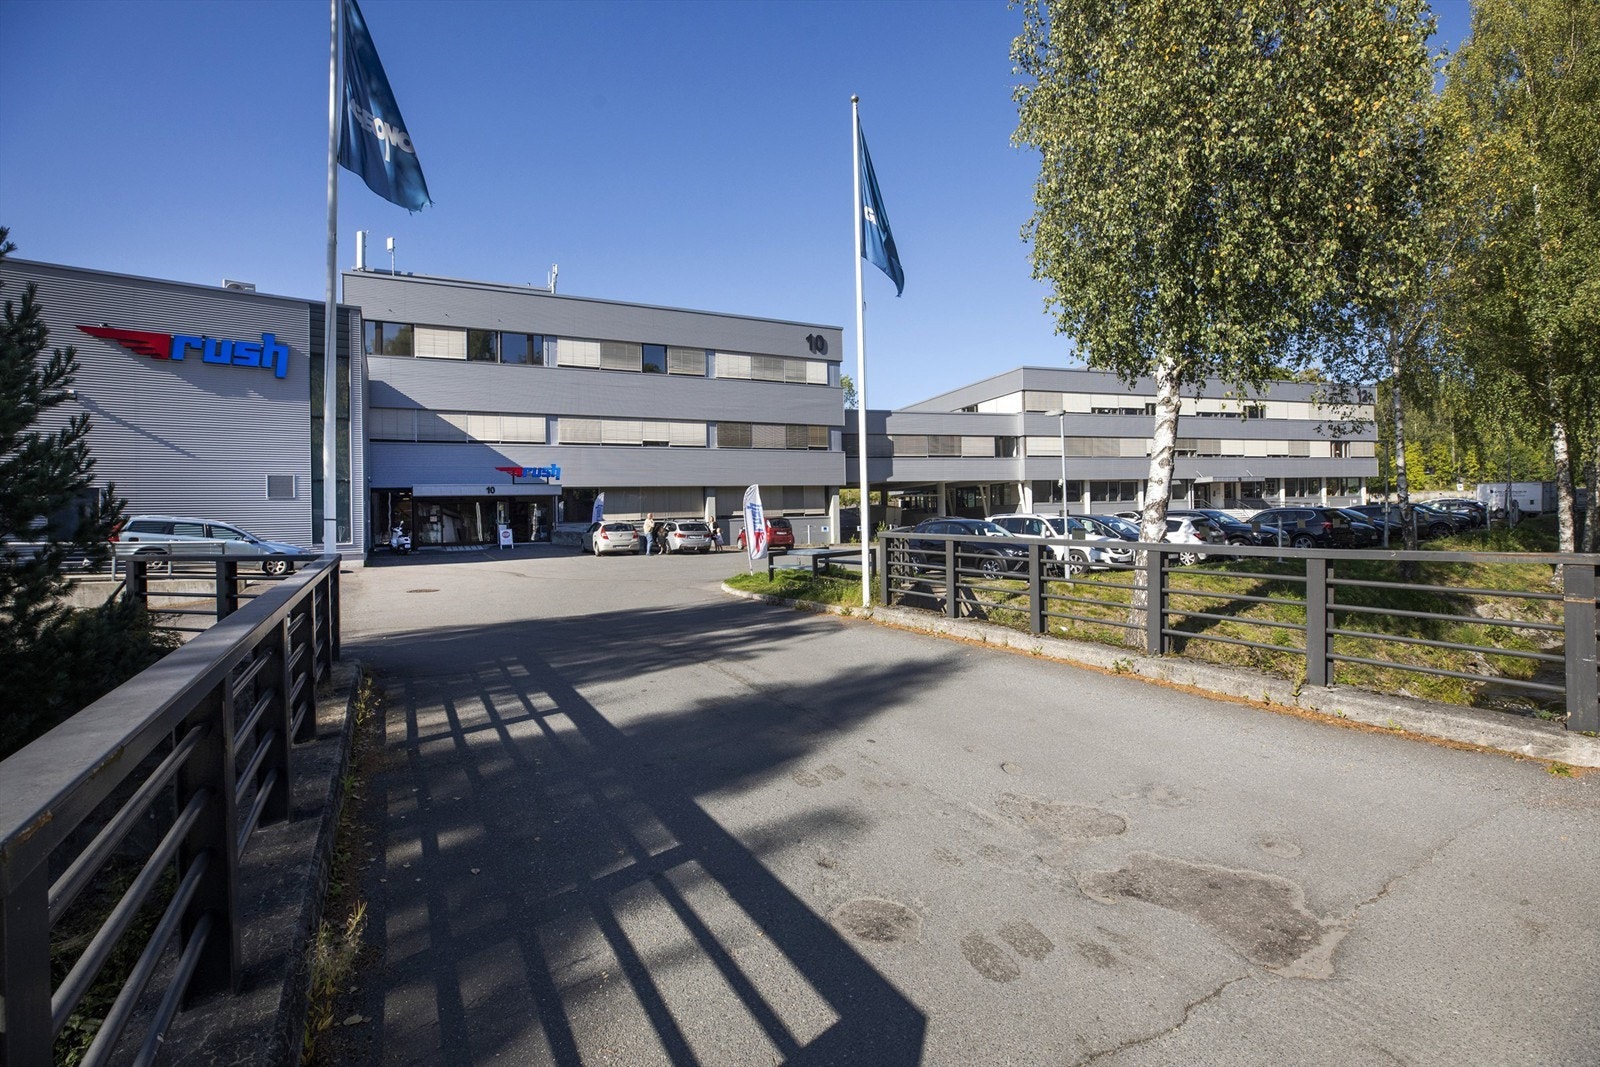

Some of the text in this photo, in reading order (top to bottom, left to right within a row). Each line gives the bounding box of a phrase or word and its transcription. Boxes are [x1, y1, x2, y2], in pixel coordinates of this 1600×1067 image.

[806, 333, 826, 353] 10
[171, 332, 289, 379] rush
[522, 463, 561, 480] rush
[486, 486, 496, 494] 10
